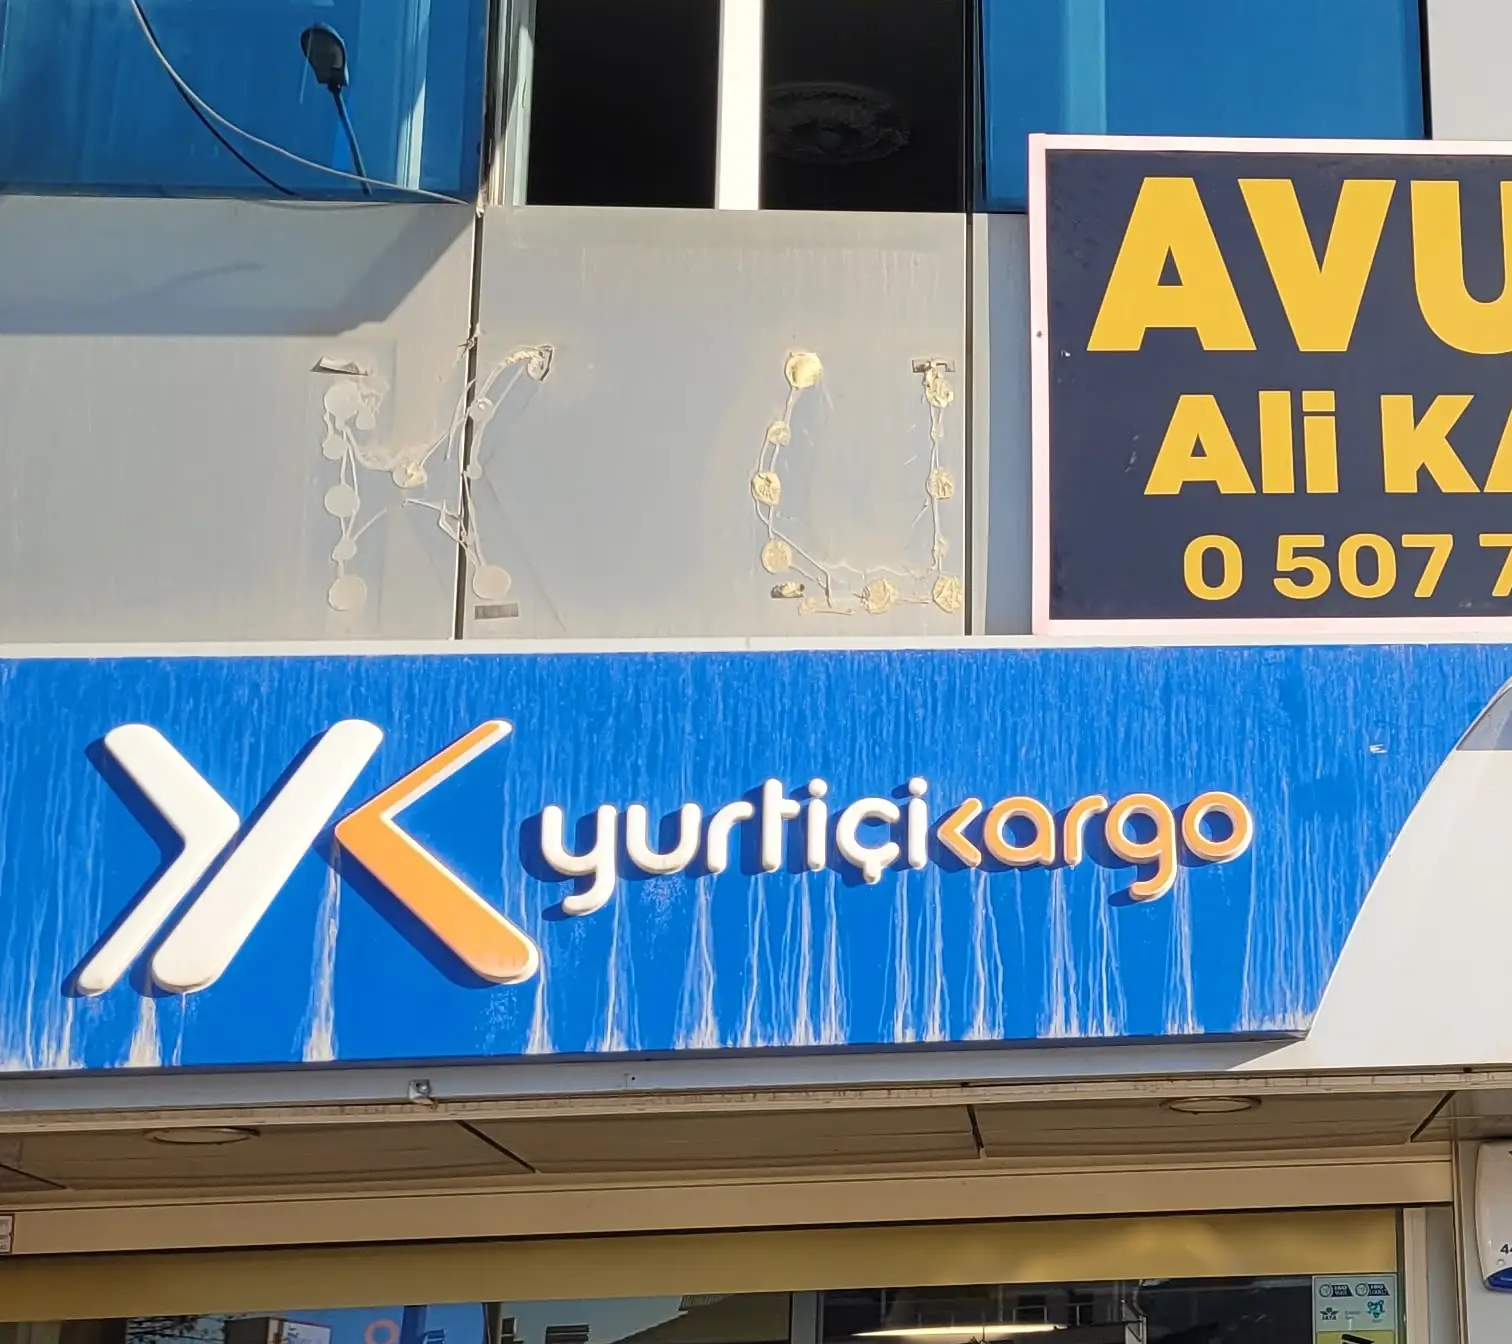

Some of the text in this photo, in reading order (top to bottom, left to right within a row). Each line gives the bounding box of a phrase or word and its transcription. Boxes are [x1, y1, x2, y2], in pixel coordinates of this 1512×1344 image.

[1143, 389, 1339, 496] Ali
[1183, 533, 1244, 601] 0
[1273, 532, 1454, 600] 507
[540, 775, 1254, 917] yurtiçikargo
